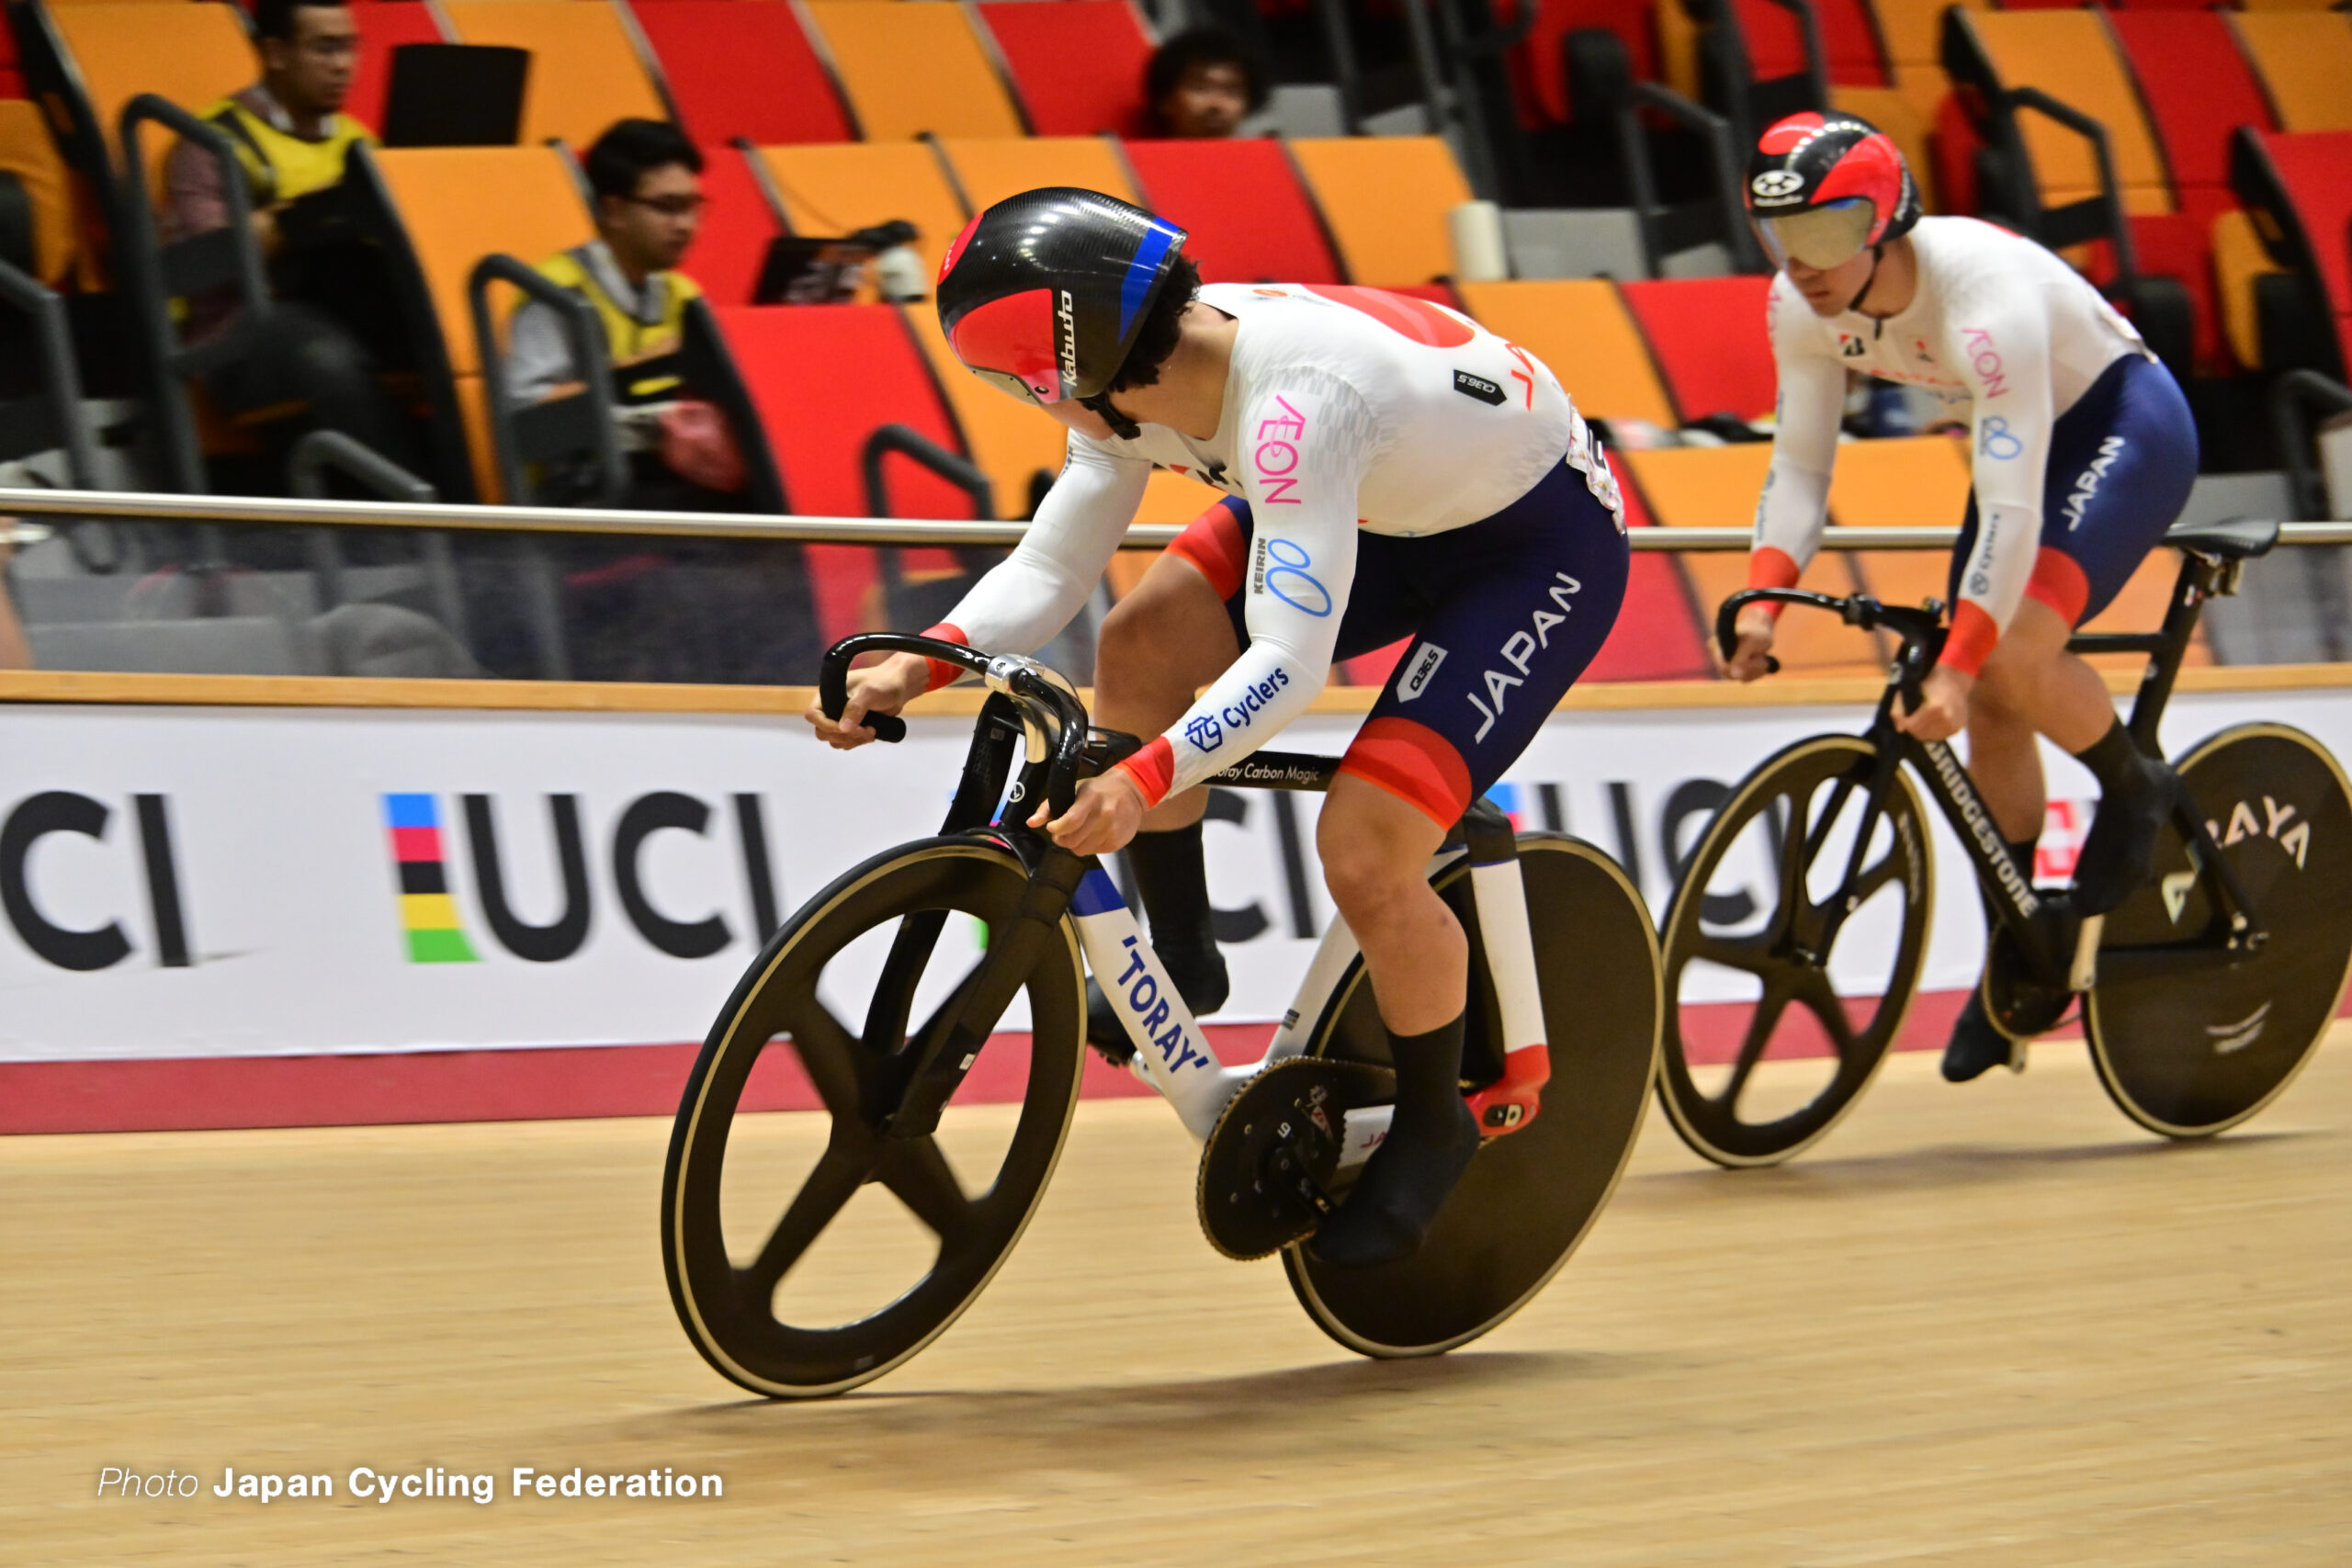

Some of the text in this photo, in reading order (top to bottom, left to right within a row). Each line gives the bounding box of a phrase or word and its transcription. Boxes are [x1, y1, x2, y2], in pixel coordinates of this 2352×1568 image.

[1057, 289, 1078, 387] Kabuto
[2060, 434, 2126, 532] JAPAN
[1253, 536, 1267, 595] KEIRIN
[1222, 667, 1289, 728] Cyclers
[1466, 570, 1582, 745] JAPAN
[1244, 762, 1284, 780] Carbon
[1285, 765, 1319, 784] Magic
[458, 790, 783, 964] UCI
